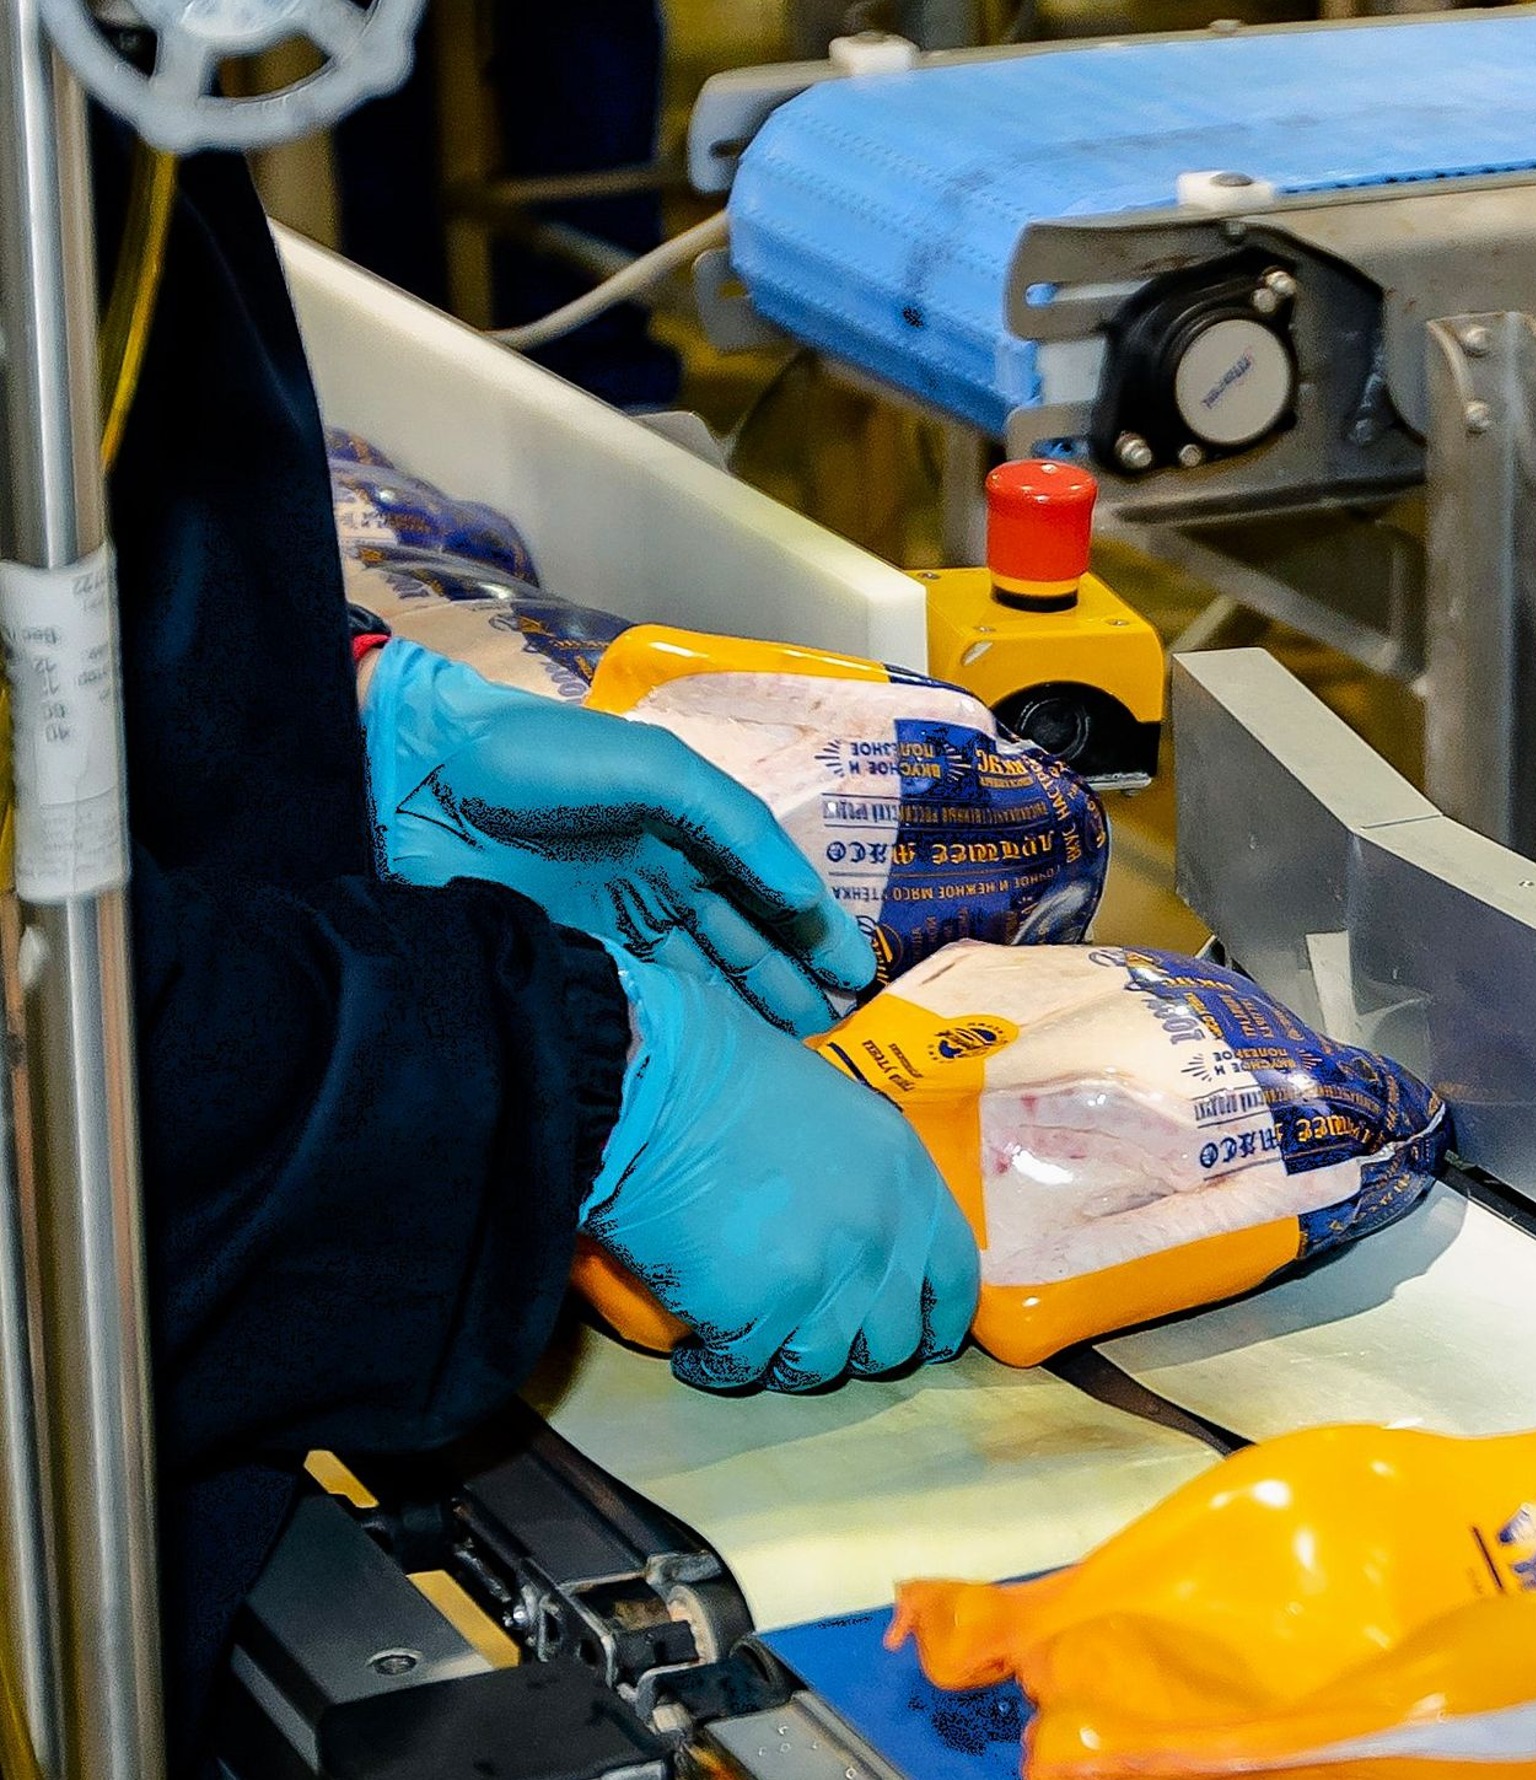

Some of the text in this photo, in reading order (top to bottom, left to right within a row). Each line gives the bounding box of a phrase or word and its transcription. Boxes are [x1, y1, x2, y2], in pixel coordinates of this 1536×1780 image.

[850, 742, 935, 759] ПОЛЕЗНОЕ
[867, 762, 942, 779] ВКУСНОЕ
[892, 886, 934, 902] МЯСО
[938, 880, 996, 900] НЕЖНОЕ
